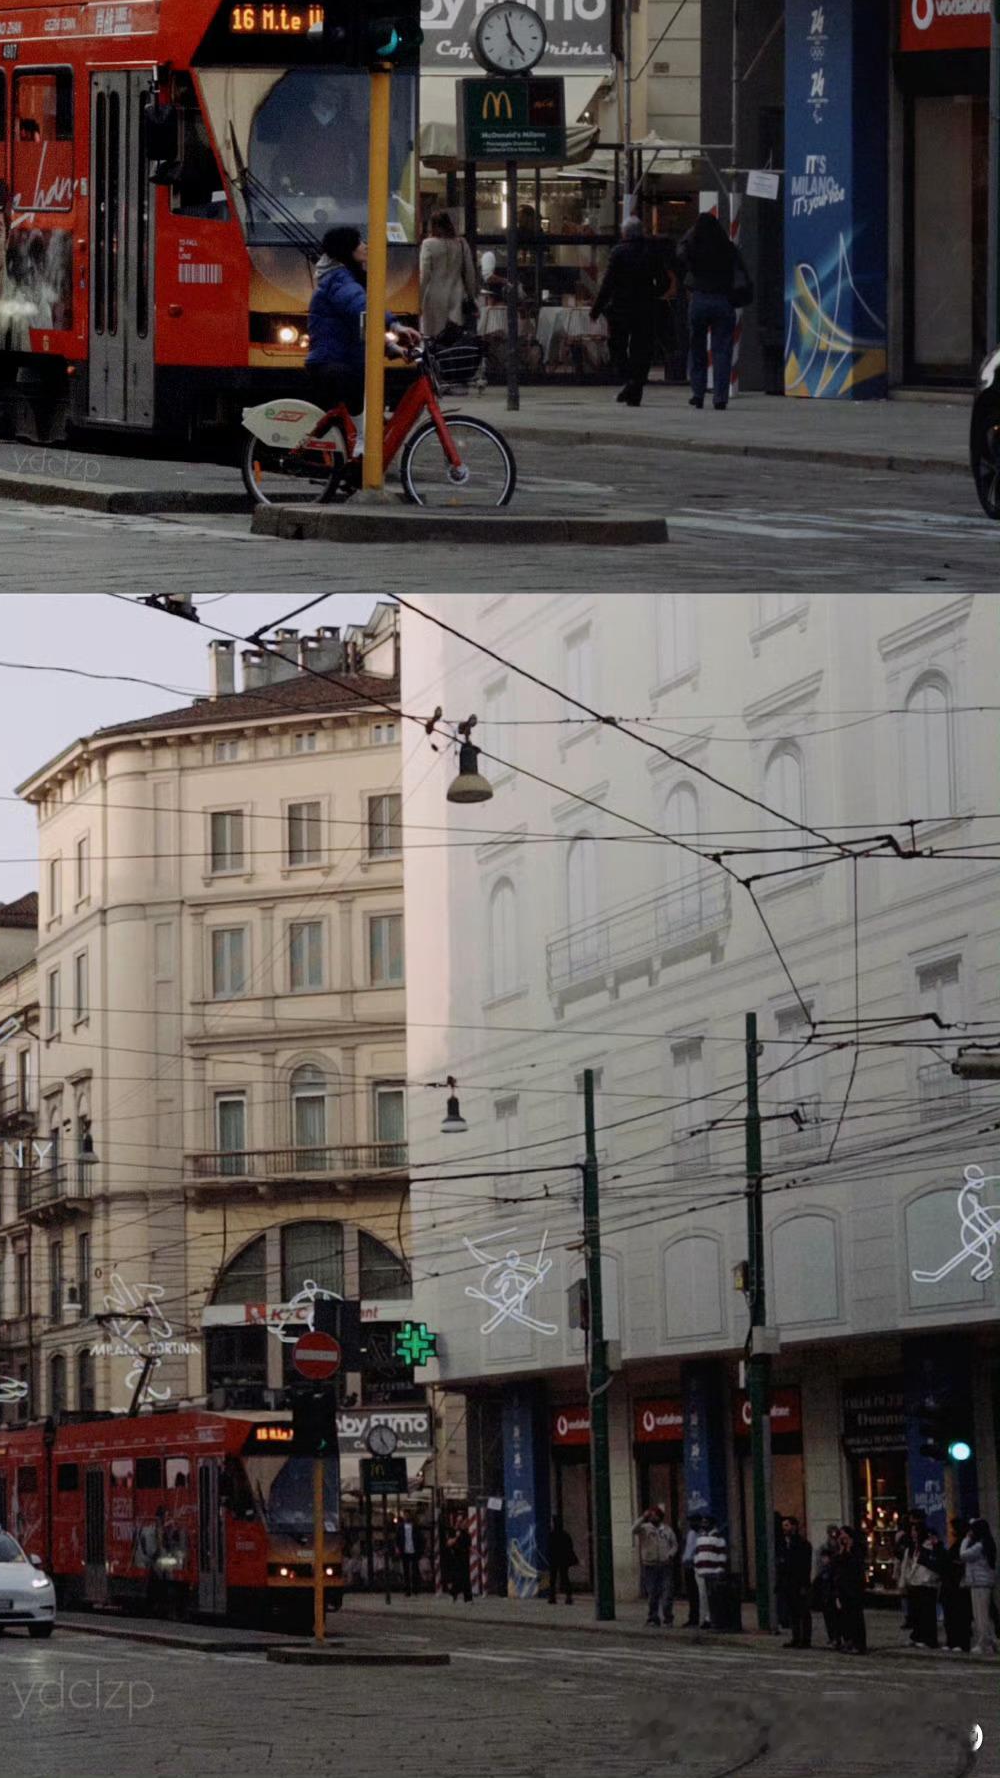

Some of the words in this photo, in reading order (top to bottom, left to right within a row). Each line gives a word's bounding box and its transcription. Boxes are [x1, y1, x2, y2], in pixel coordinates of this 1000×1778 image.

[232, 8, 255, 30] 16
[262, 8, 302, 30] M.te
[806, 154, 827, 174] IT'S
